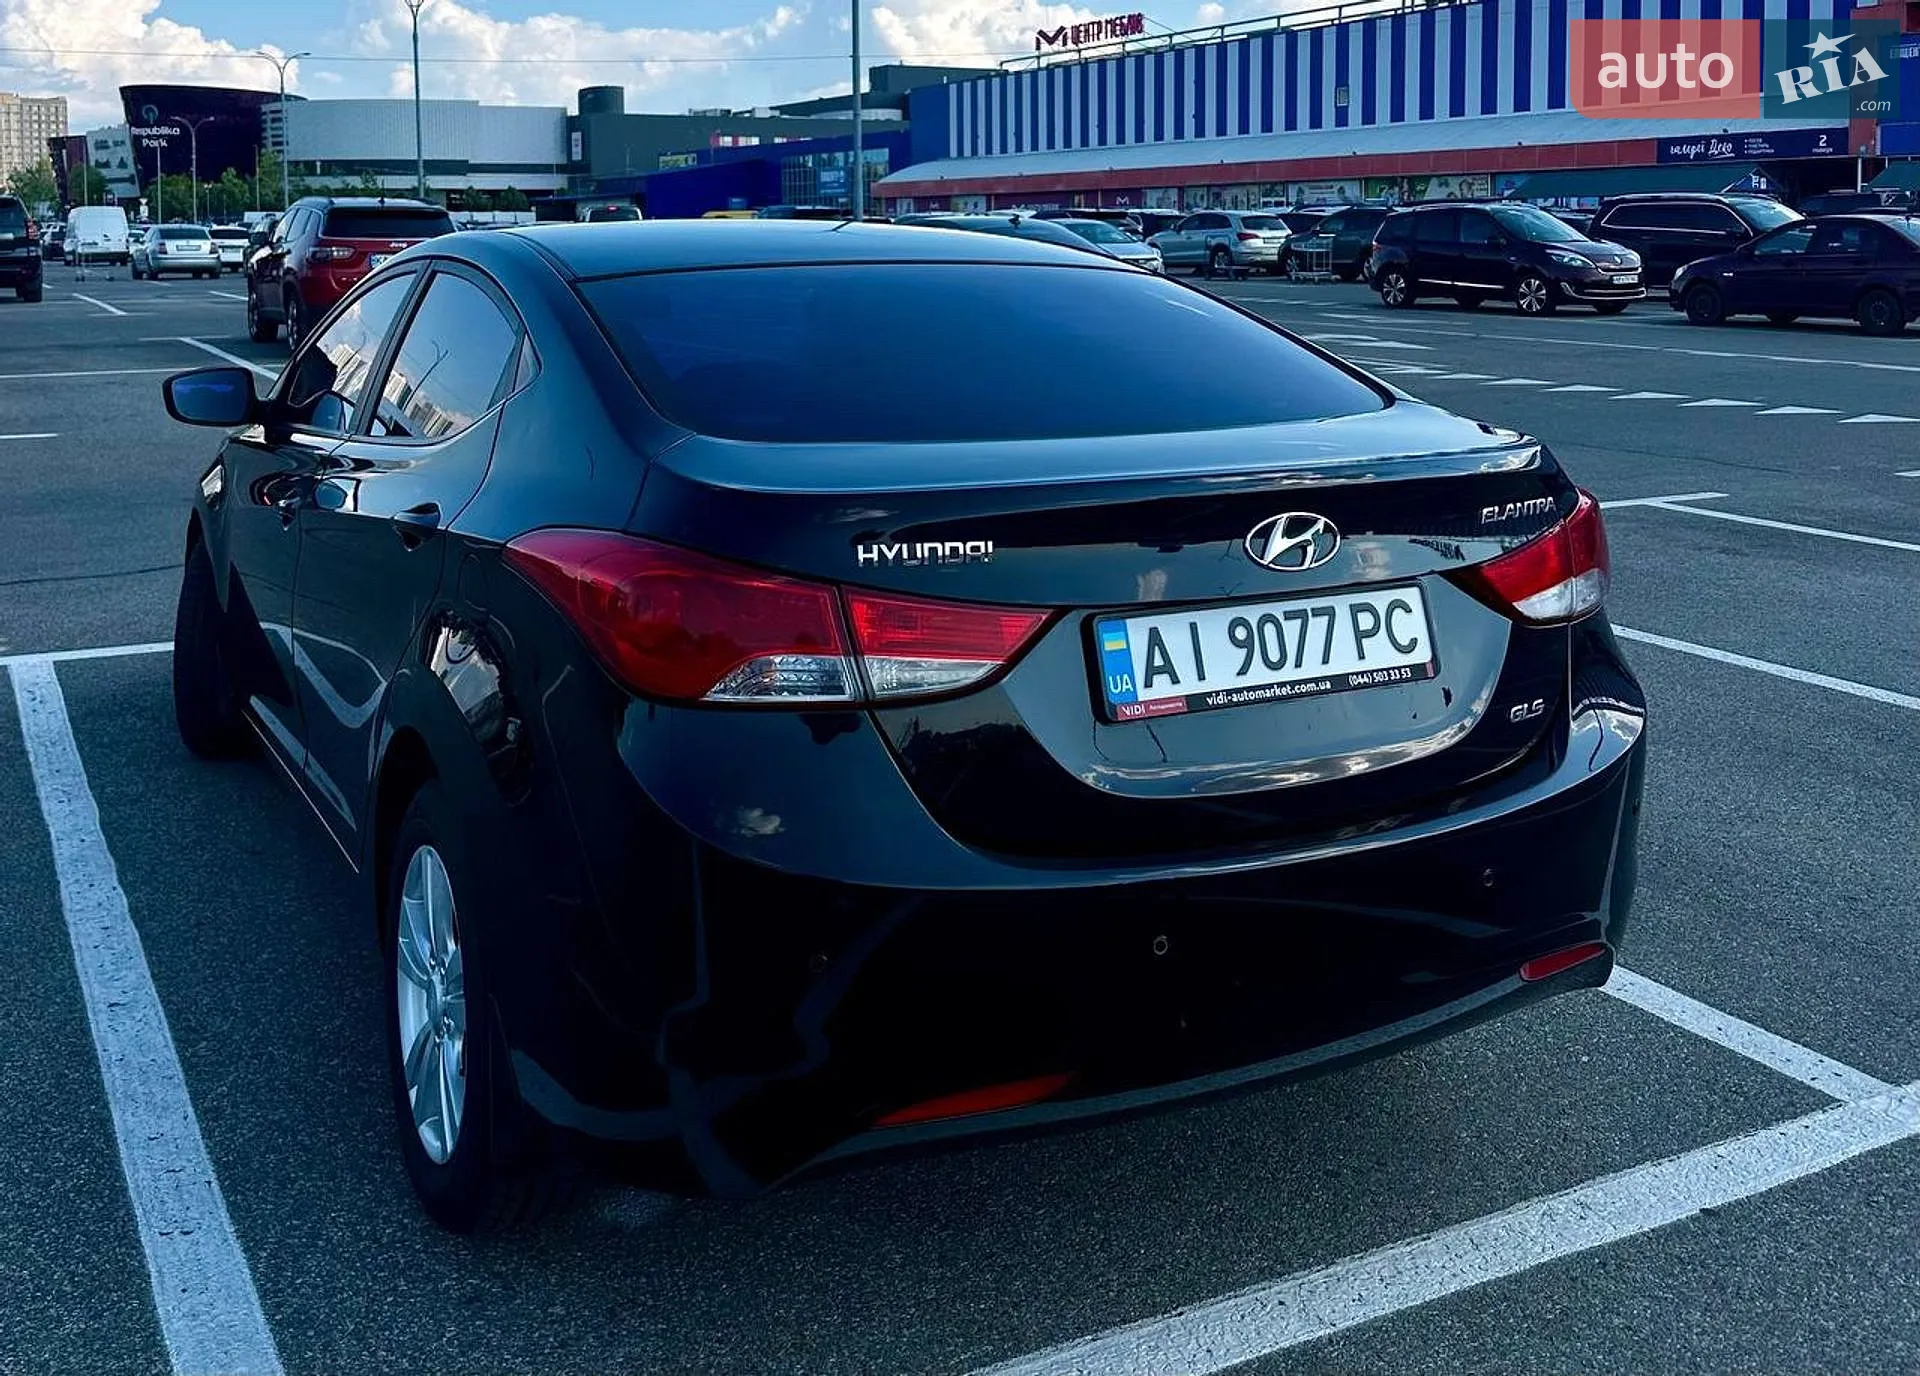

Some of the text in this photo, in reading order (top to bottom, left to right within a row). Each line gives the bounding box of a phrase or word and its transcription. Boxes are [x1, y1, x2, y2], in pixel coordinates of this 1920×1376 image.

[1071, 20, 1103, 46] ЦЕНТР
[142, 138, 168, 148] Park
[1818, 134, 1828, 147] 2
[1481, 496, 1557, 524] ELANTRA
[857, 540, 993, 566] HYUNDAI
[1144, 598, 1419, 688] AI 9077 PC
[1108, 674, 1134, 693] UA
[1206, 681, 1332, 705] vidi-automarket.com.ua
[1348, 673, 1372, 688] (044)
[1373, 671, 1389, 683] 503
[1389, 669, 1401, 681] 33
[1401, 667, 1412, 680] 53
[1121, 704, 1146, 717] VIDI
[1511, 699, 1545, 722] GLS
